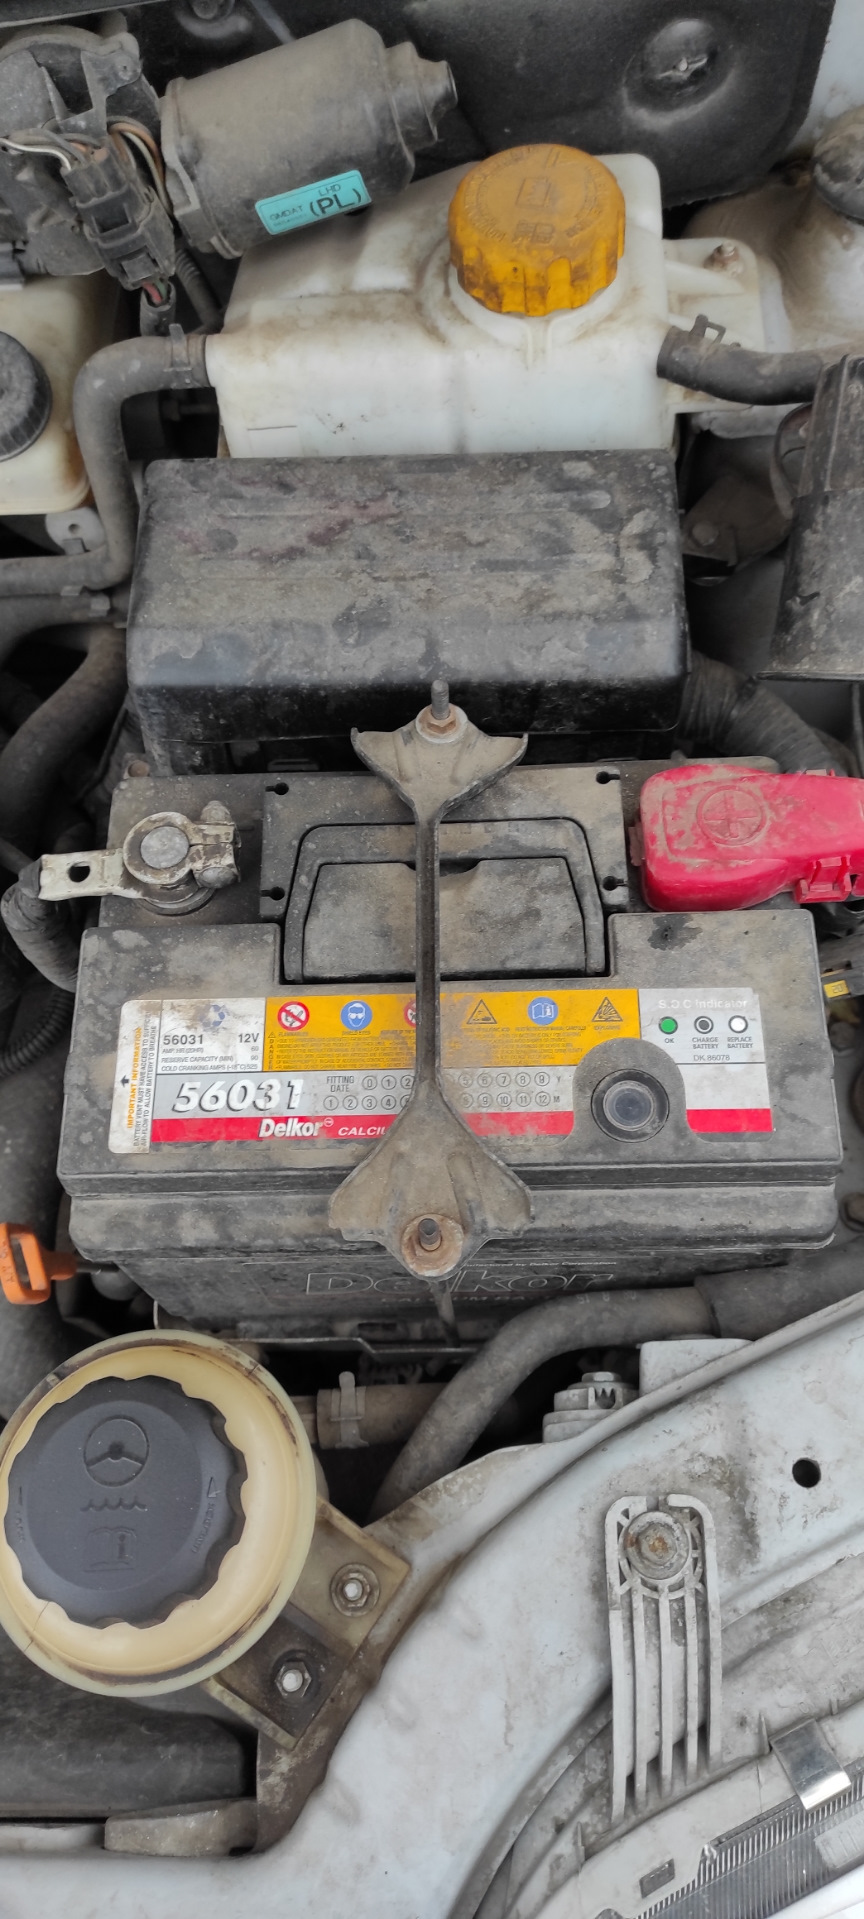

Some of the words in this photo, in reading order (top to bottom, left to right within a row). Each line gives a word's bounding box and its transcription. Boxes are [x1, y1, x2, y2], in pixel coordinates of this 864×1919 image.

[309, 188, 362, 217] (PL)
[318, 184, 341, 196] LHD
[149, 1026, 157, 1050] BREATHE
[163, 1034, 204, 1046] 56031
[238, 1033, 260, 1043] 12V
[131, 1027, 142, 1080] INFORMATION
[146, 1061, 154, 1086] BATTERY
[127, 1083, 137, 1129] IMPORTANT
[172, 1079, 304, 1112] 56031
[133, 1121, 141, 1146] BATTERY
[137, 1088, 145, 1103] MUST
[259, 1118, 323, 1137] Delkor
[338, 1126, 386, 1136] CALCI
